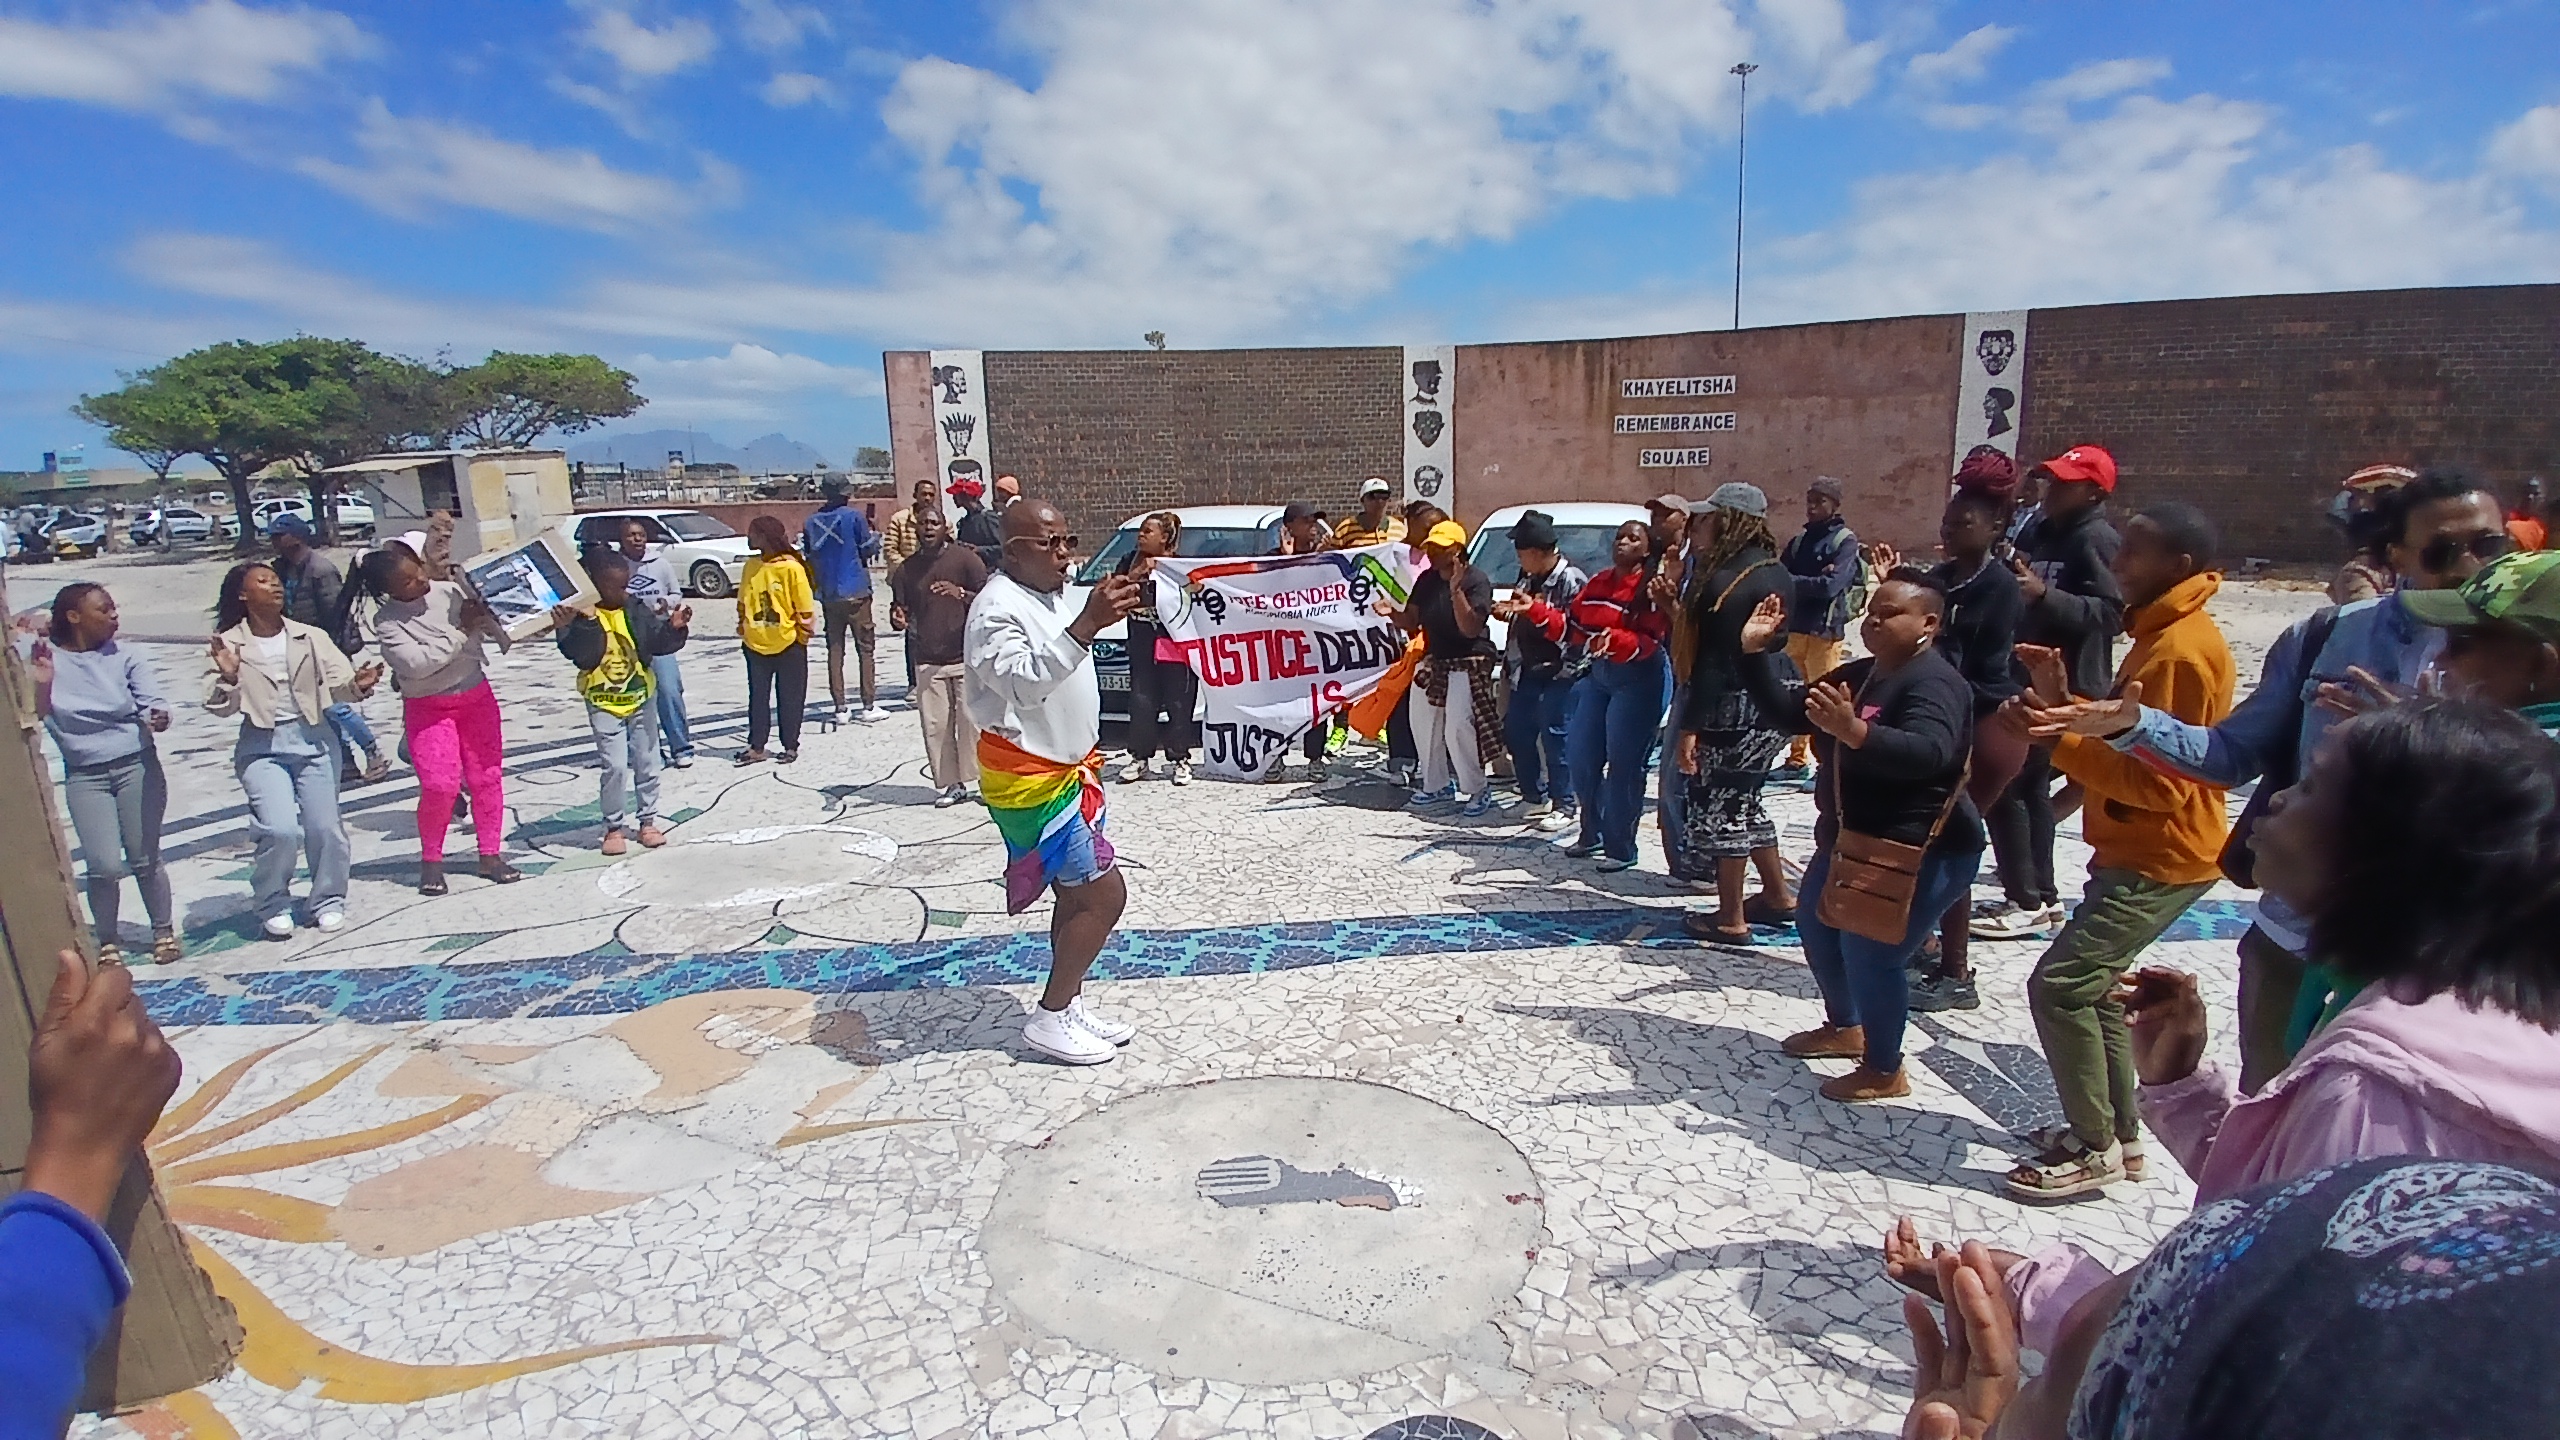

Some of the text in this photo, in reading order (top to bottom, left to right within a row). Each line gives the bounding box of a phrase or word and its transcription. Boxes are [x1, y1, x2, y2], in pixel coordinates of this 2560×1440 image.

[1623, 378, 1734, 396] KHAYELITSHA
[1616, 414, 1734, 432] REMEMBRANCE
[1642, 449, 1708, 465] SQUARE
[1272, 583, 1348, 609] GENDER
[1305, 604, 1339, 618] HURTS
[1311, 680, 1350, 728] IS
